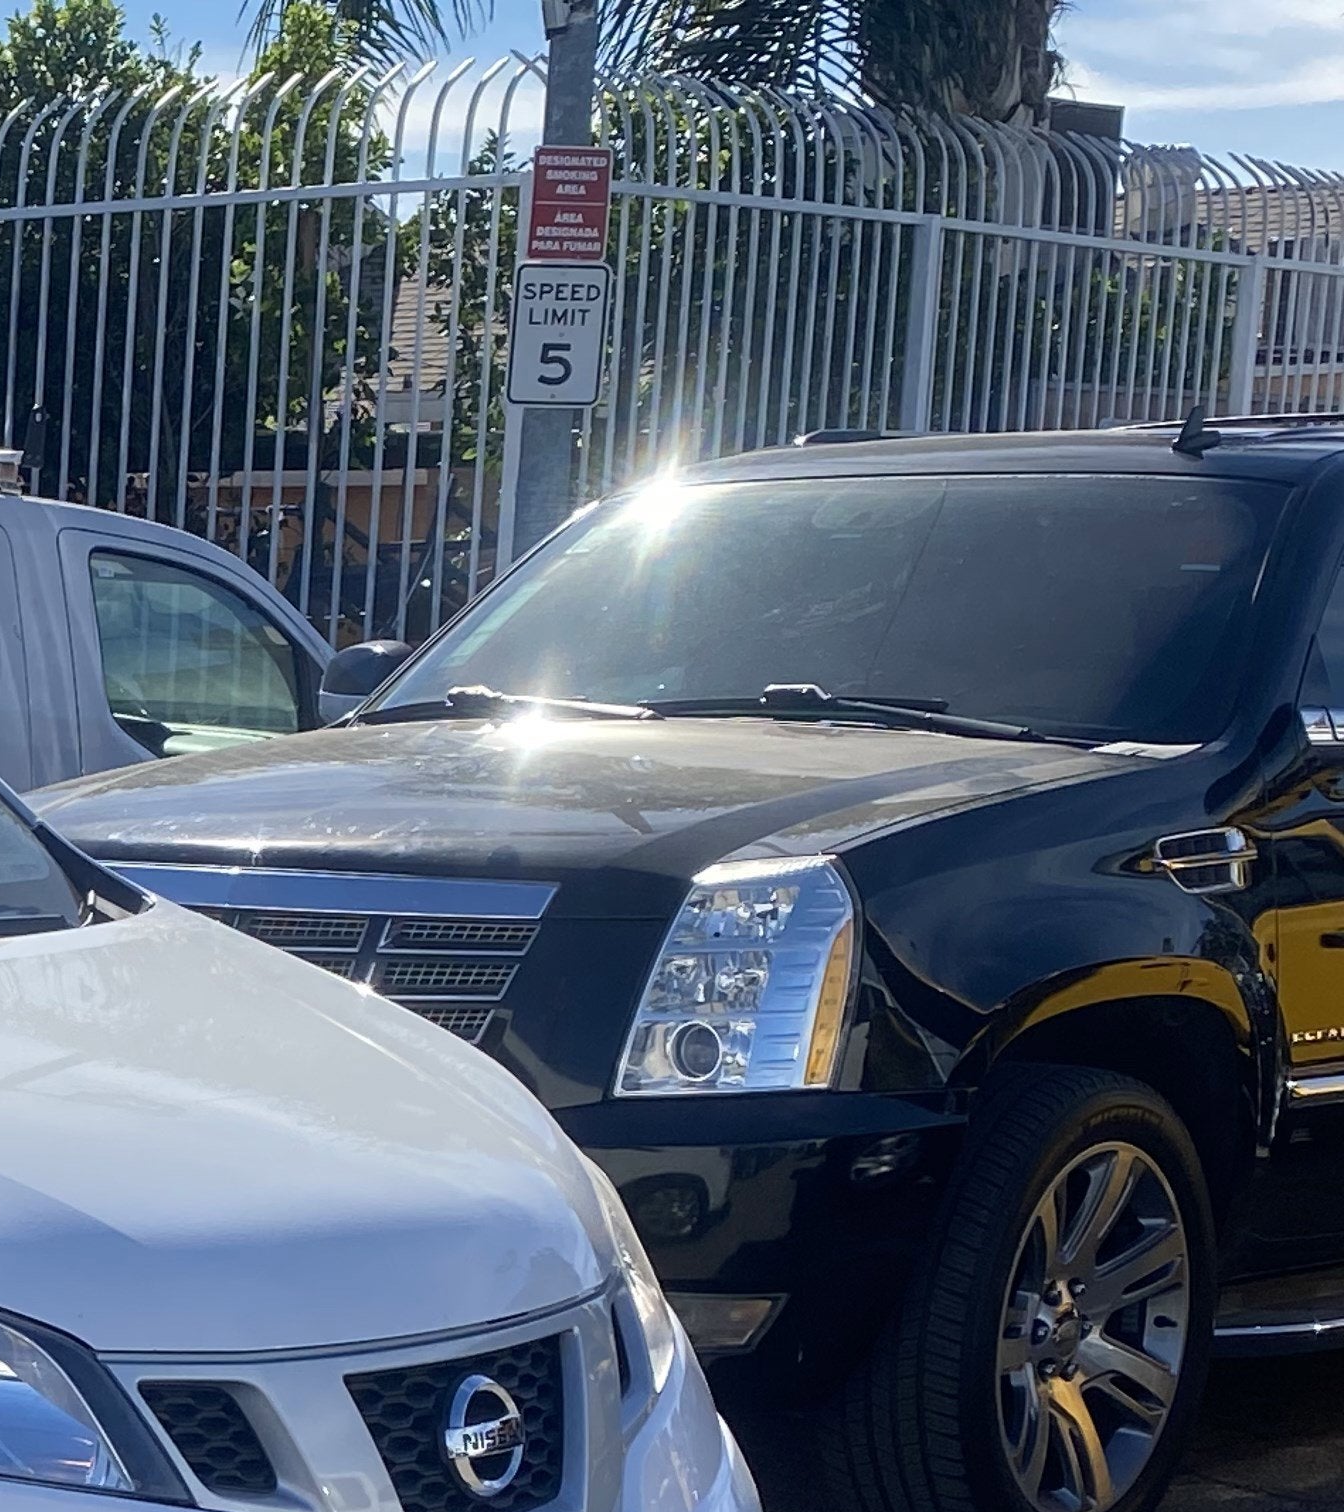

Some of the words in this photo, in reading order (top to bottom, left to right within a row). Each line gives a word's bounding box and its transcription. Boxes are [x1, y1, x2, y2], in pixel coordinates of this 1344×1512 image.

[538, 155, 607, 167] DESIGNATED
[545, 169, 598, 181] SMOKING
[555, 183, 587, 195] AREA
[536, 226, 599, 238] DESIGNADA
[531, 240, 560, 251] PARA
[562, 241, 602, 252] FUMAR
[522, 283, 601, 302] SPEED
[528, 307, 591, 327] LIMIT
[537, 343, 573, 386] 5
